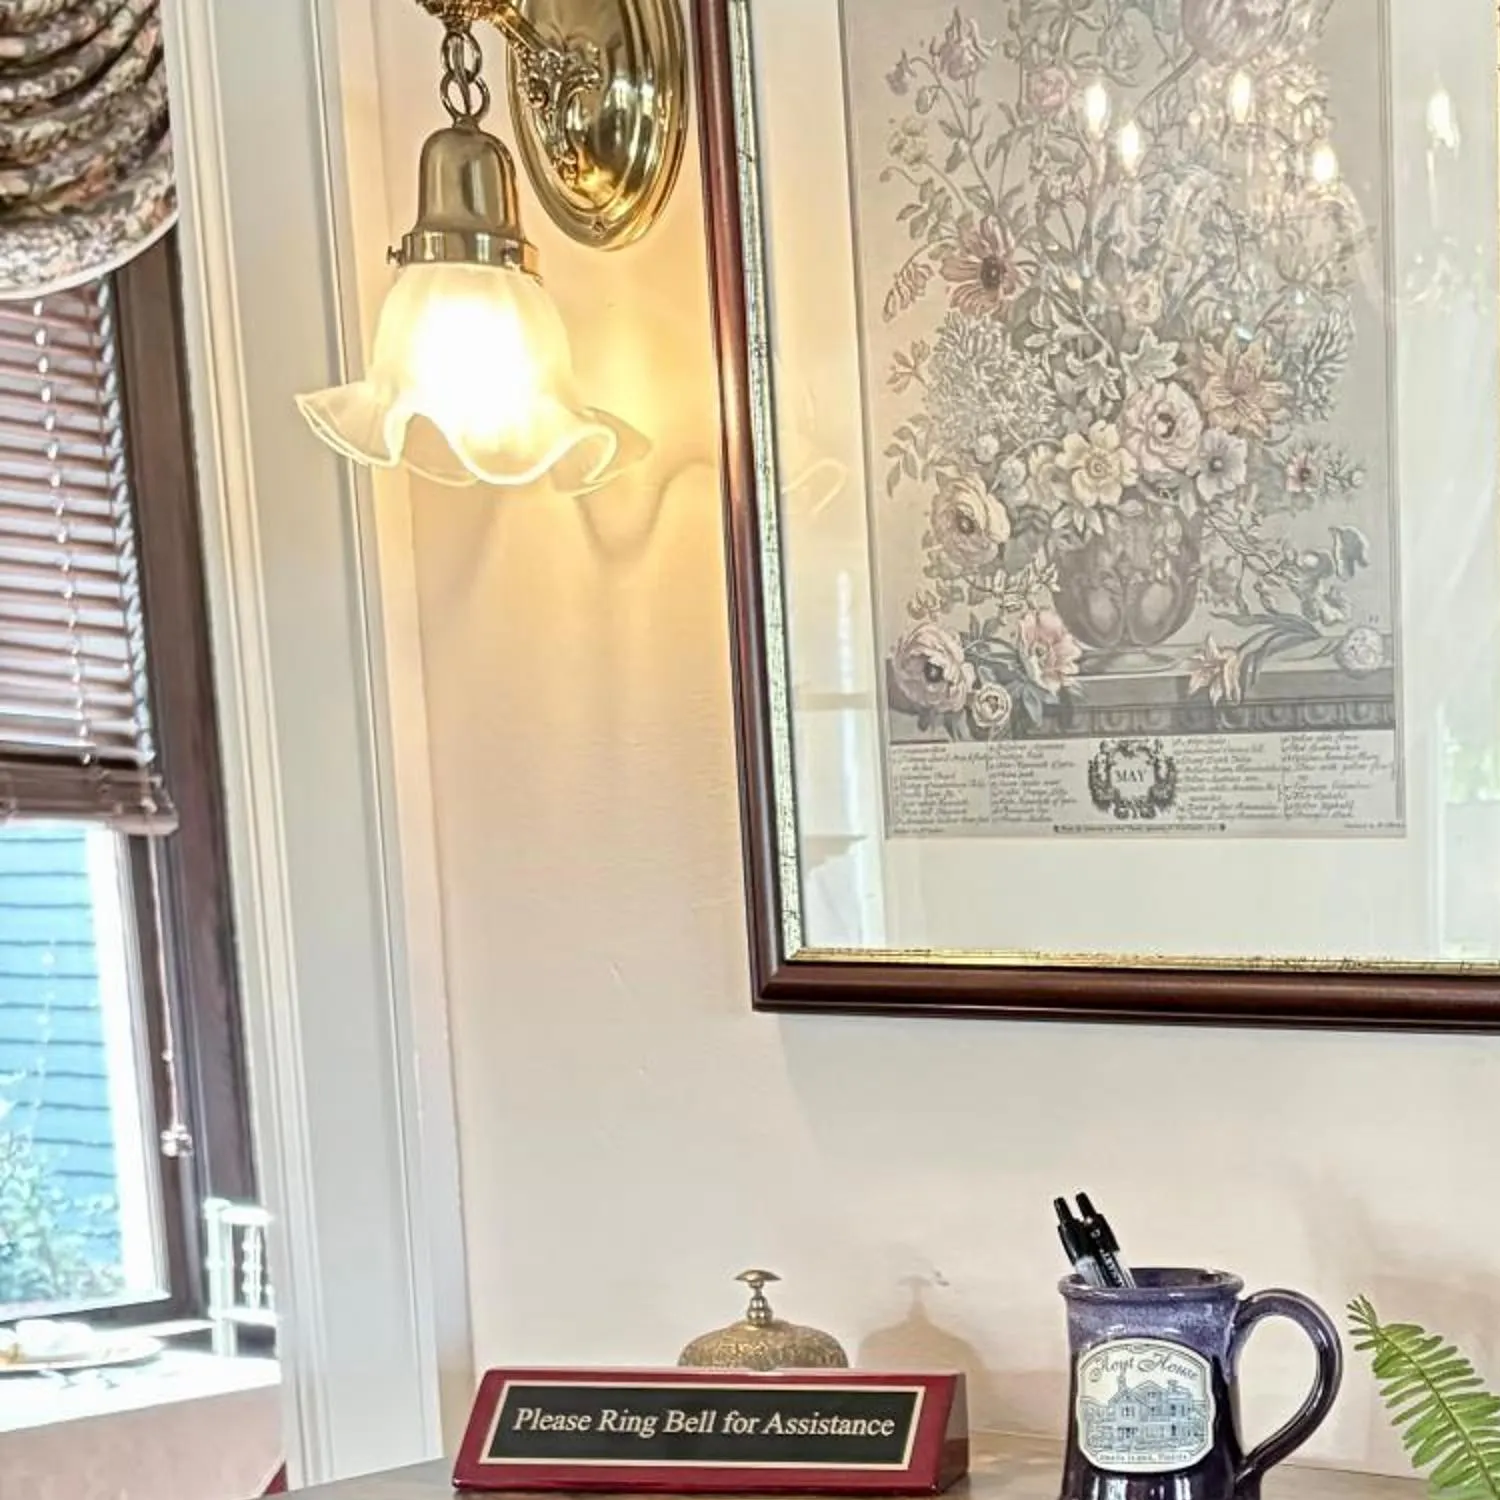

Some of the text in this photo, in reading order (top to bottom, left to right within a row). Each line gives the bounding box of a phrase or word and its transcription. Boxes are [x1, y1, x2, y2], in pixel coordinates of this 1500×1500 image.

[1115, 768, 1148, 782] MAY
[1137, 1352, 1199, 1380] House
[513, 1408, 894, 1438] Please Ring Bell for Assistance
